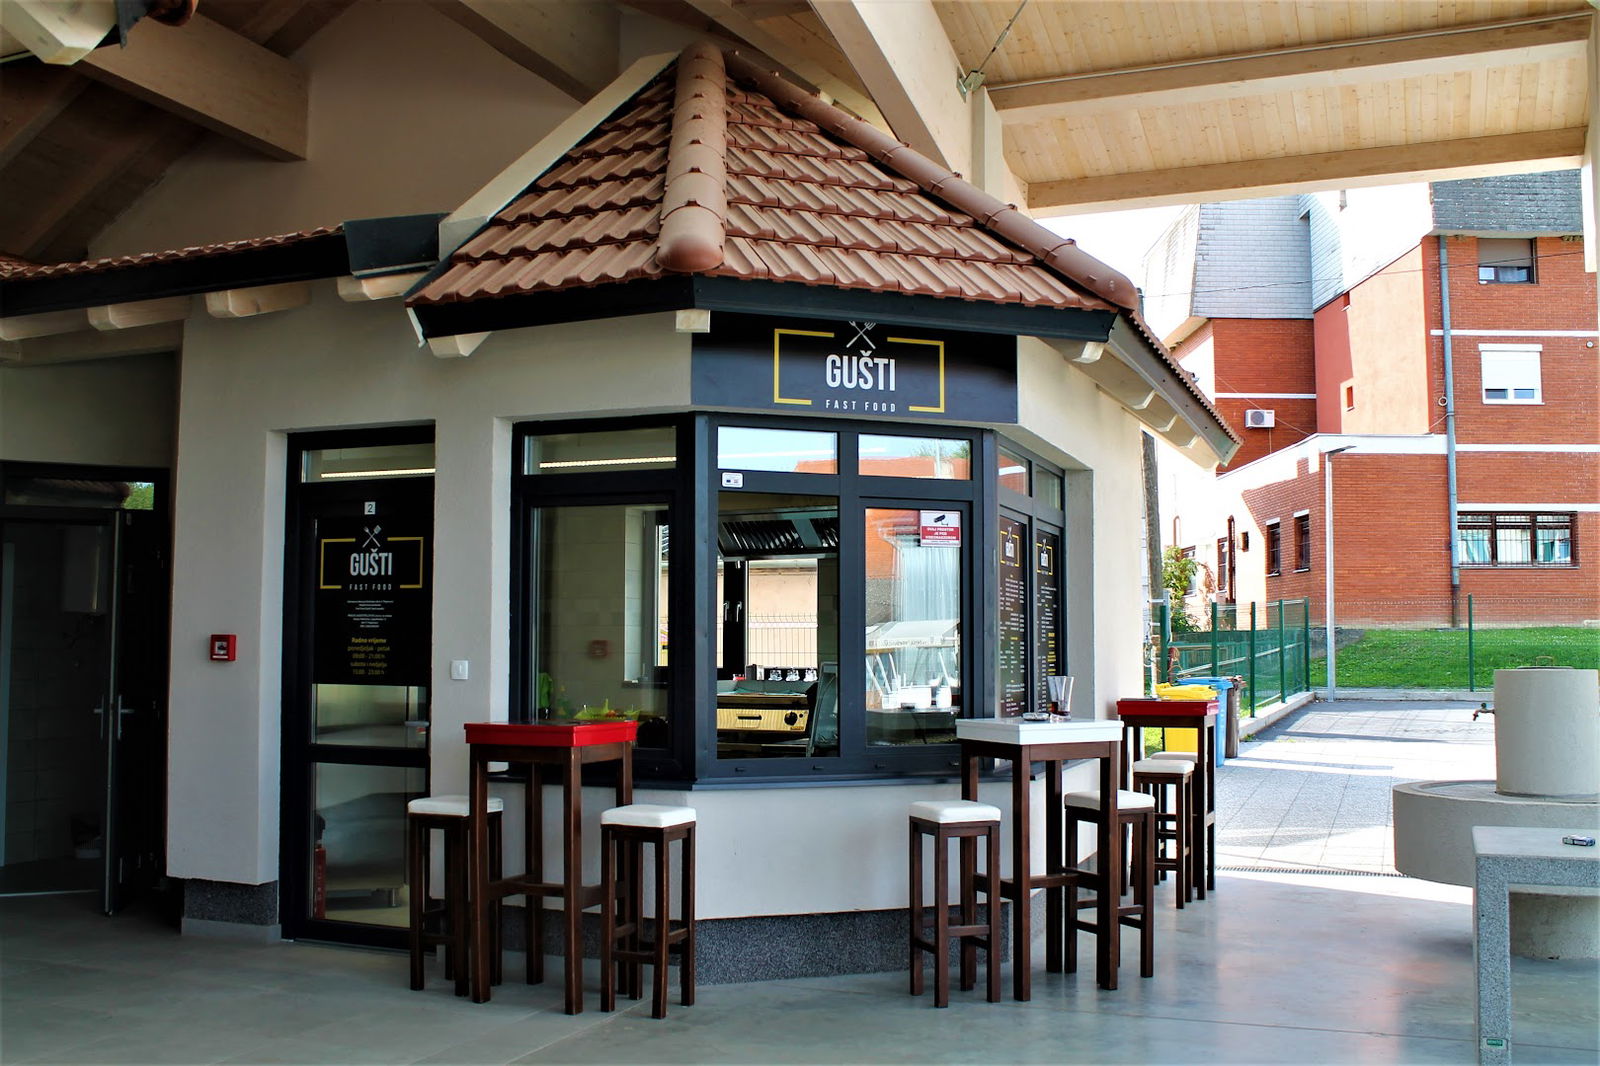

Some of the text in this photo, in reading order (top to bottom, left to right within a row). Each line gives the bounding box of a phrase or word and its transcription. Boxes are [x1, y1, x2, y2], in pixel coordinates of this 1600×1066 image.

[826, 350, 896, 391] GUŠTI
[825, 399, 896, 412] FAST FOOD
[367, 503, 374, 513] 2
[350, 548, 392, 576] GUŠTI
